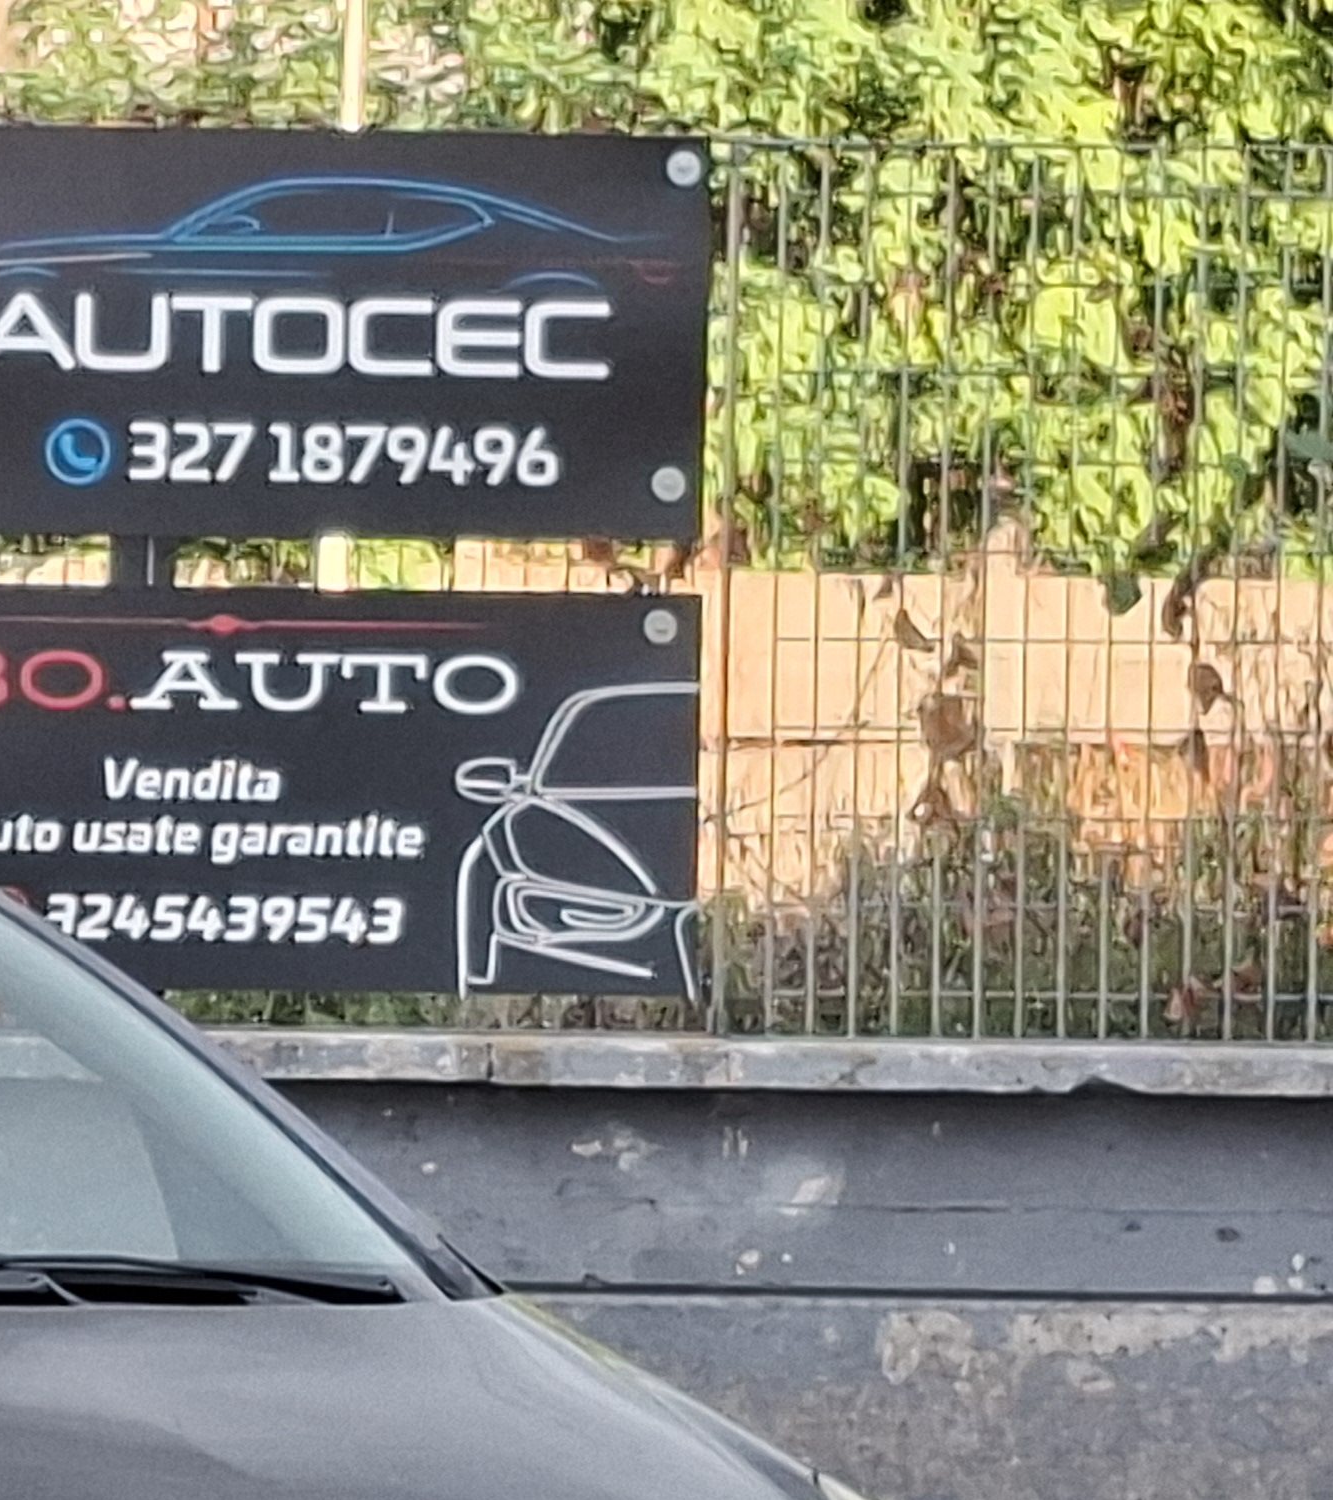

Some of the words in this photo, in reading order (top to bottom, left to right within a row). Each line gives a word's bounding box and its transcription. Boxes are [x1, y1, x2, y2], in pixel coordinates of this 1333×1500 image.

[129, 421, 254, 484] 327
[267, 424, 560, 487] 1879496
[102, 756, 283, 803] Vendita
[71, 815, 201, 854] usate
[210, 813, 427, 864] garantite
[45, 892, 406, 945] 3245439543
